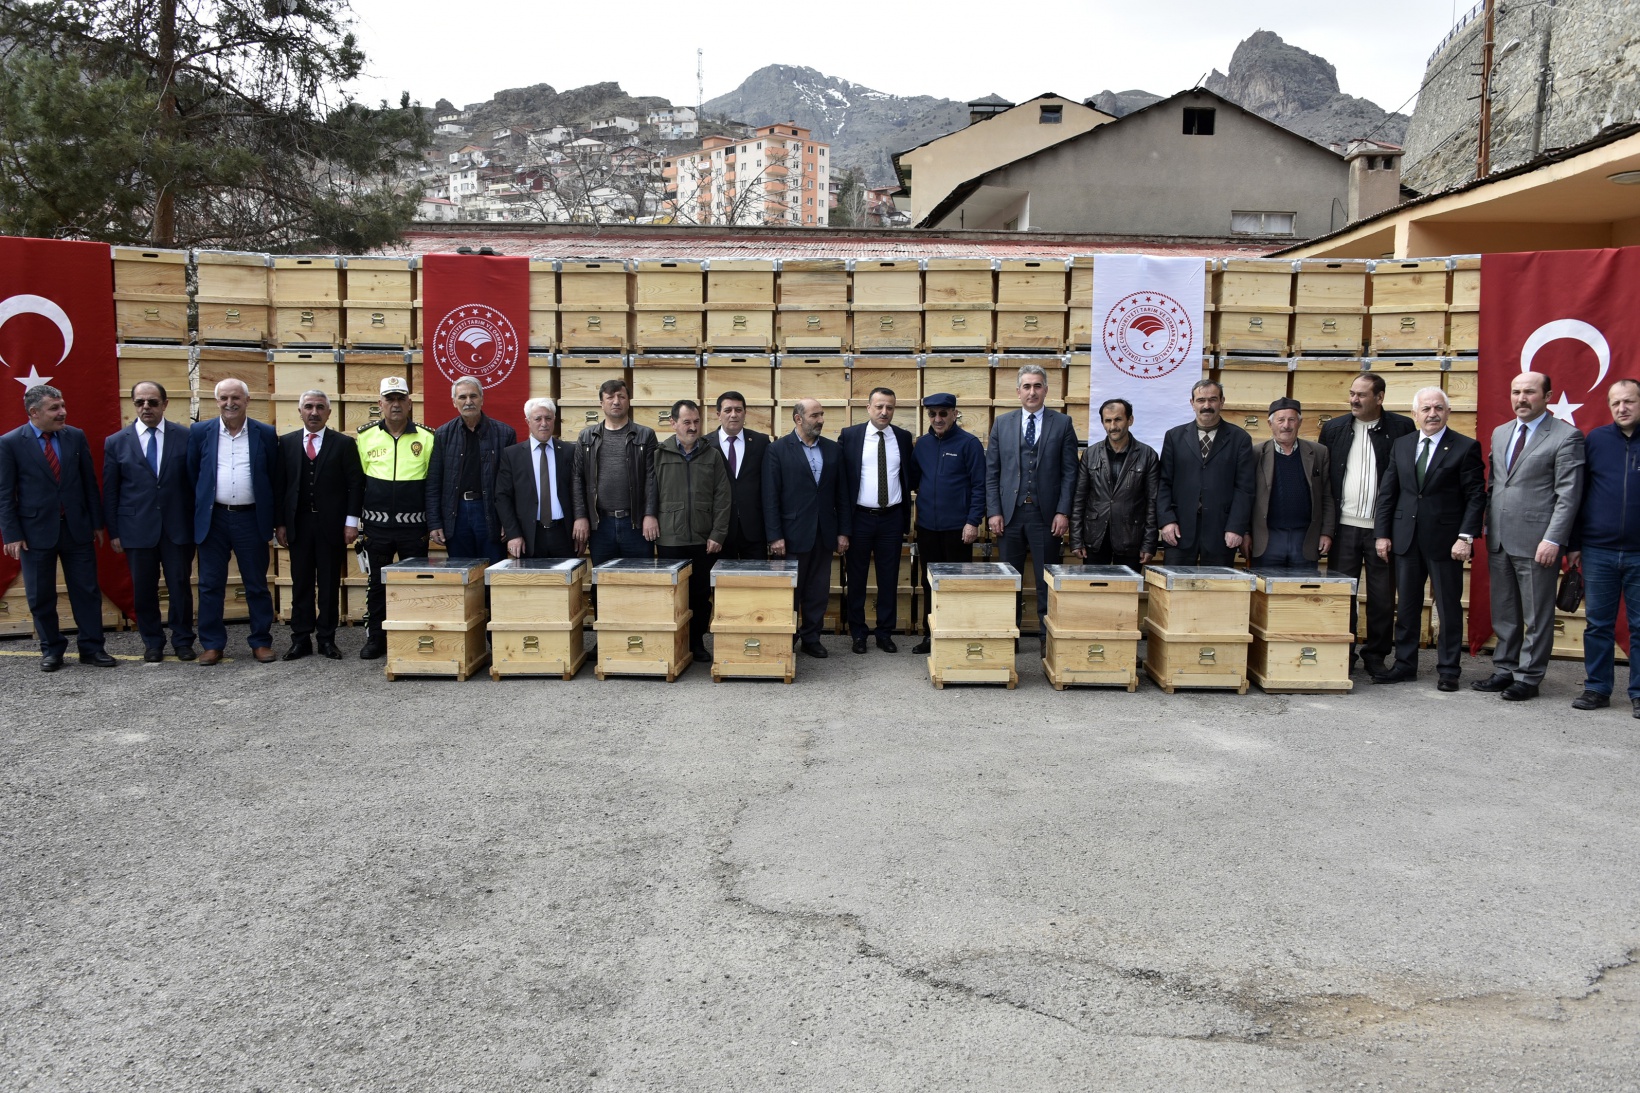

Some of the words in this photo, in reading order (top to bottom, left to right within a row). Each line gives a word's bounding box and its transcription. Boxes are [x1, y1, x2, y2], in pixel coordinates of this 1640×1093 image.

[486, 323, 493, 331] VE
[492, 329, 503, 348] ORMAN
[1165, 317, 1176, 337] ORMAN
